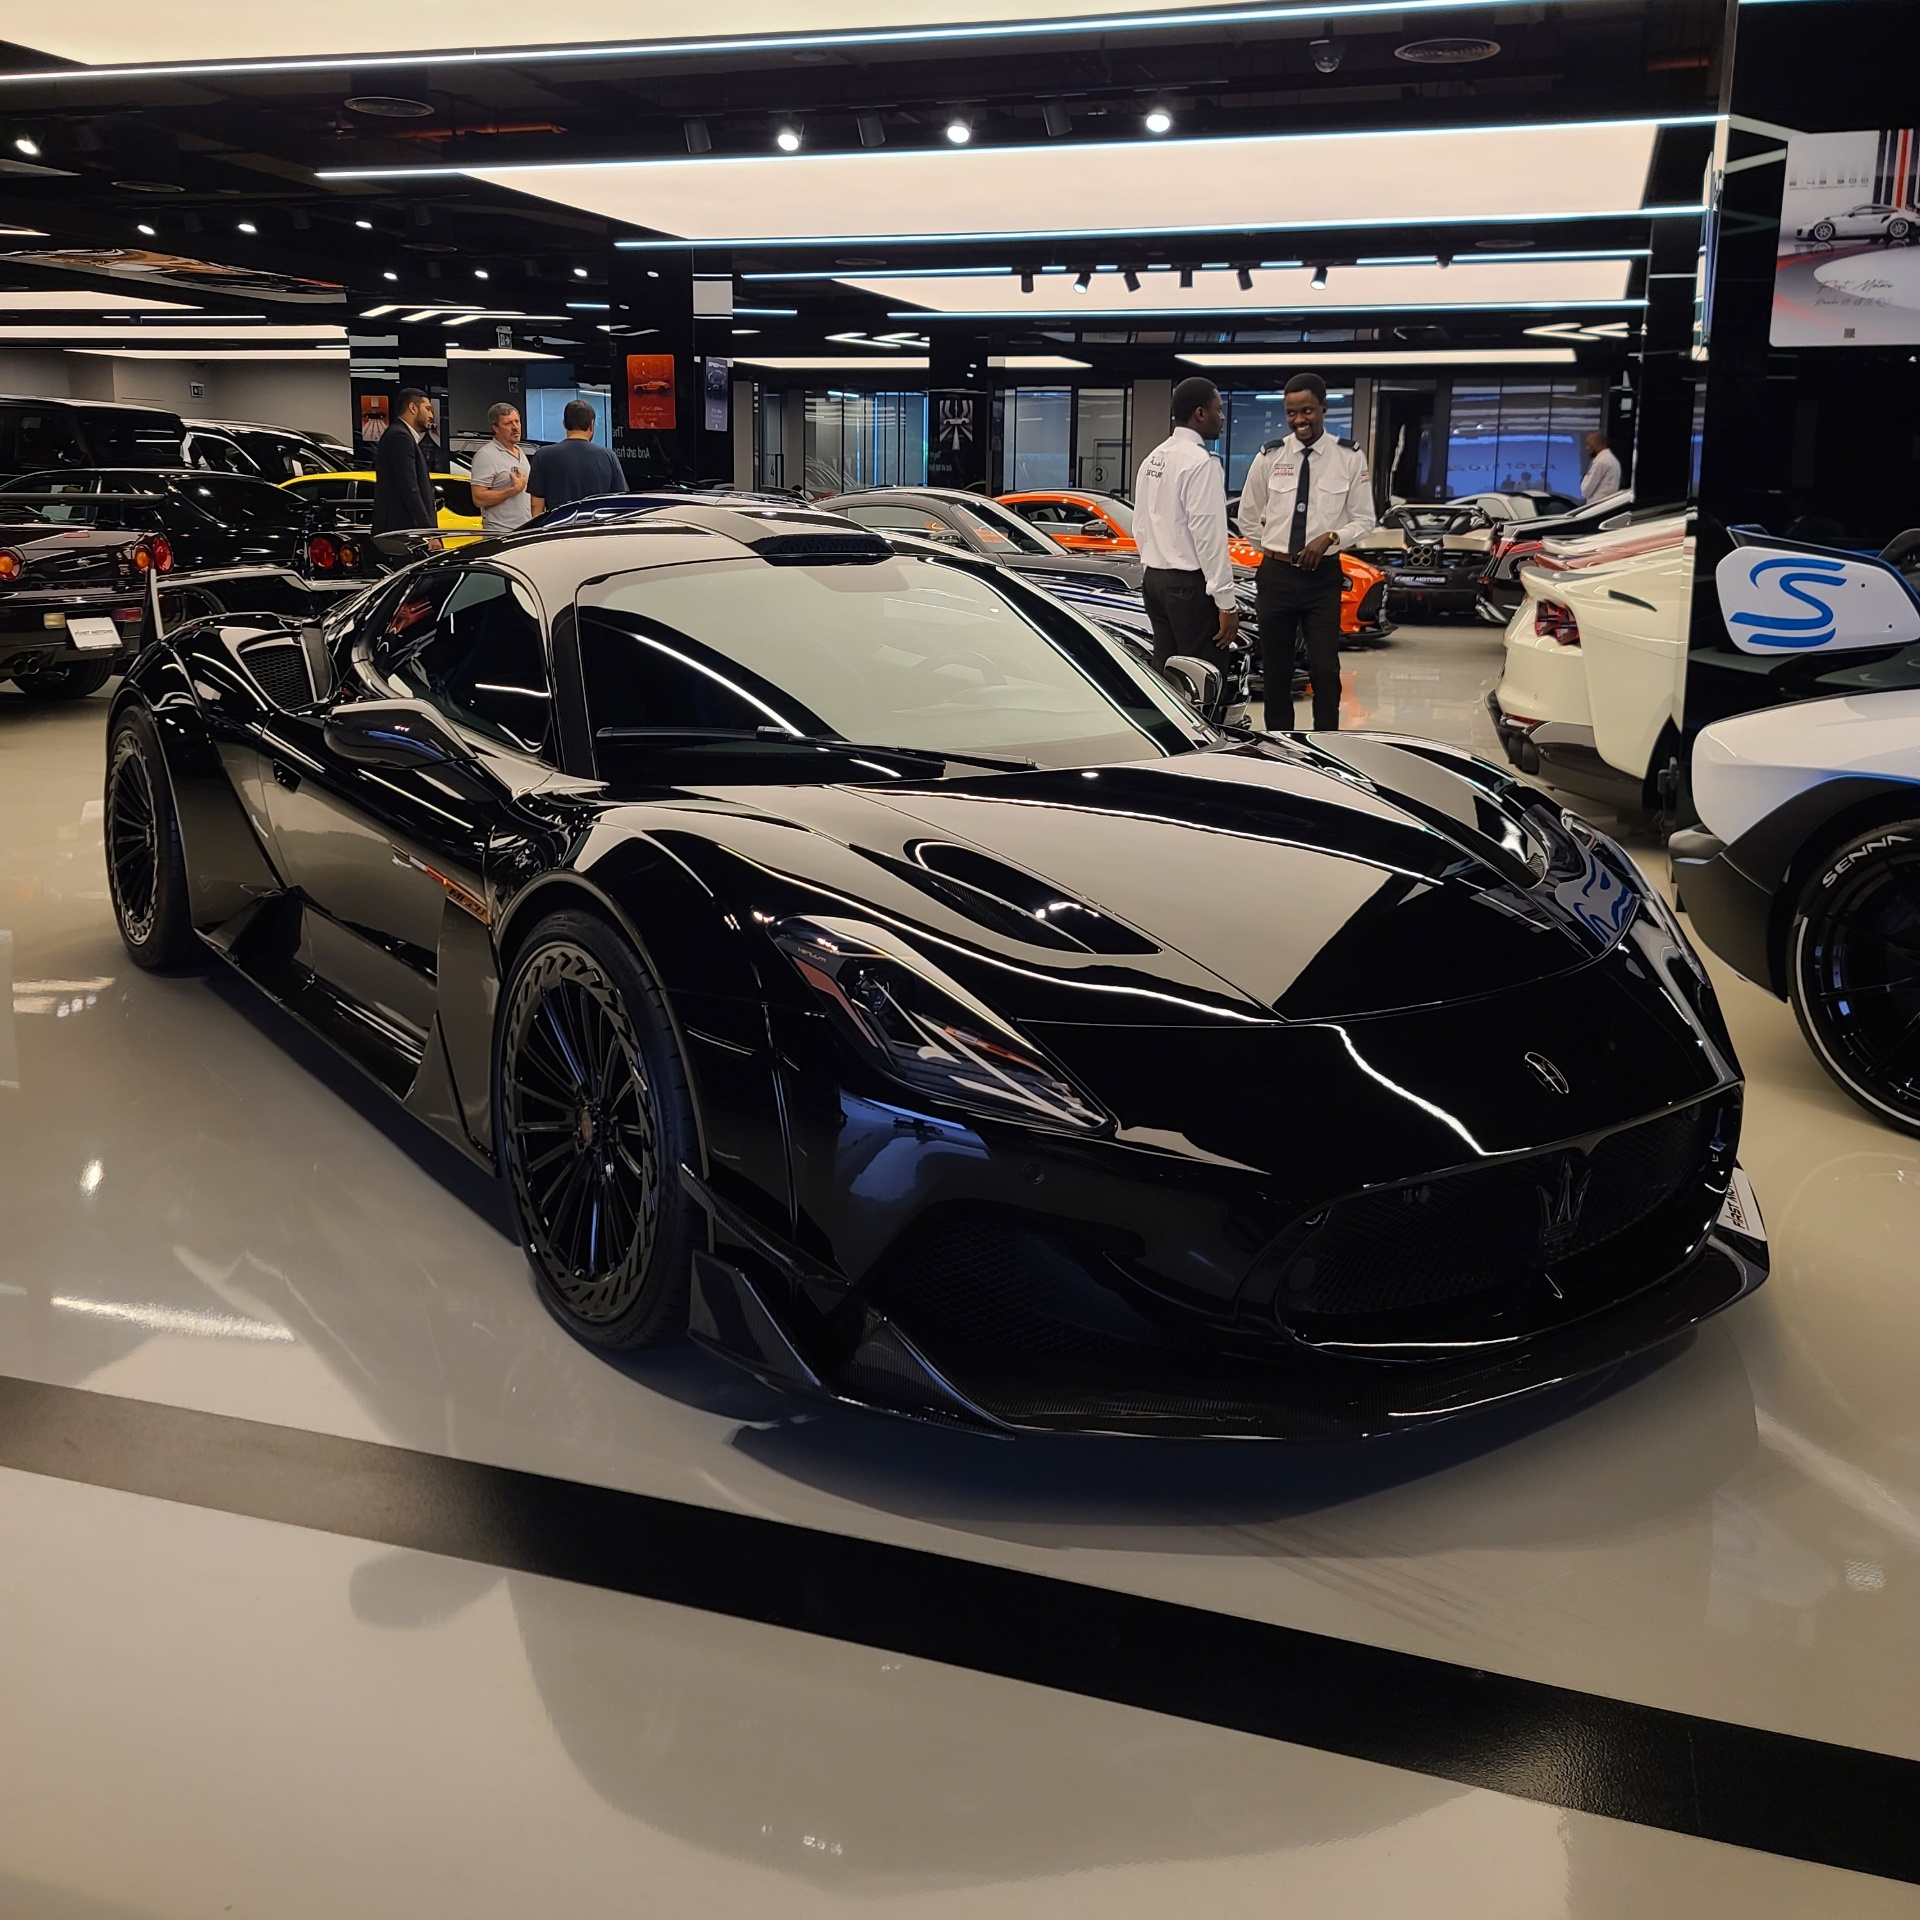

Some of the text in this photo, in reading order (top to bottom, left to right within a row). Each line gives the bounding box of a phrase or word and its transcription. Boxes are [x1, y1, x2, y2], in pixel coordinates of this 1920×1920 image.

[1094, 467, 1103, 482] 3
[1415, 576, 1446, 584] MOTORS
[1822, 835, 1913, 888] SENNA
